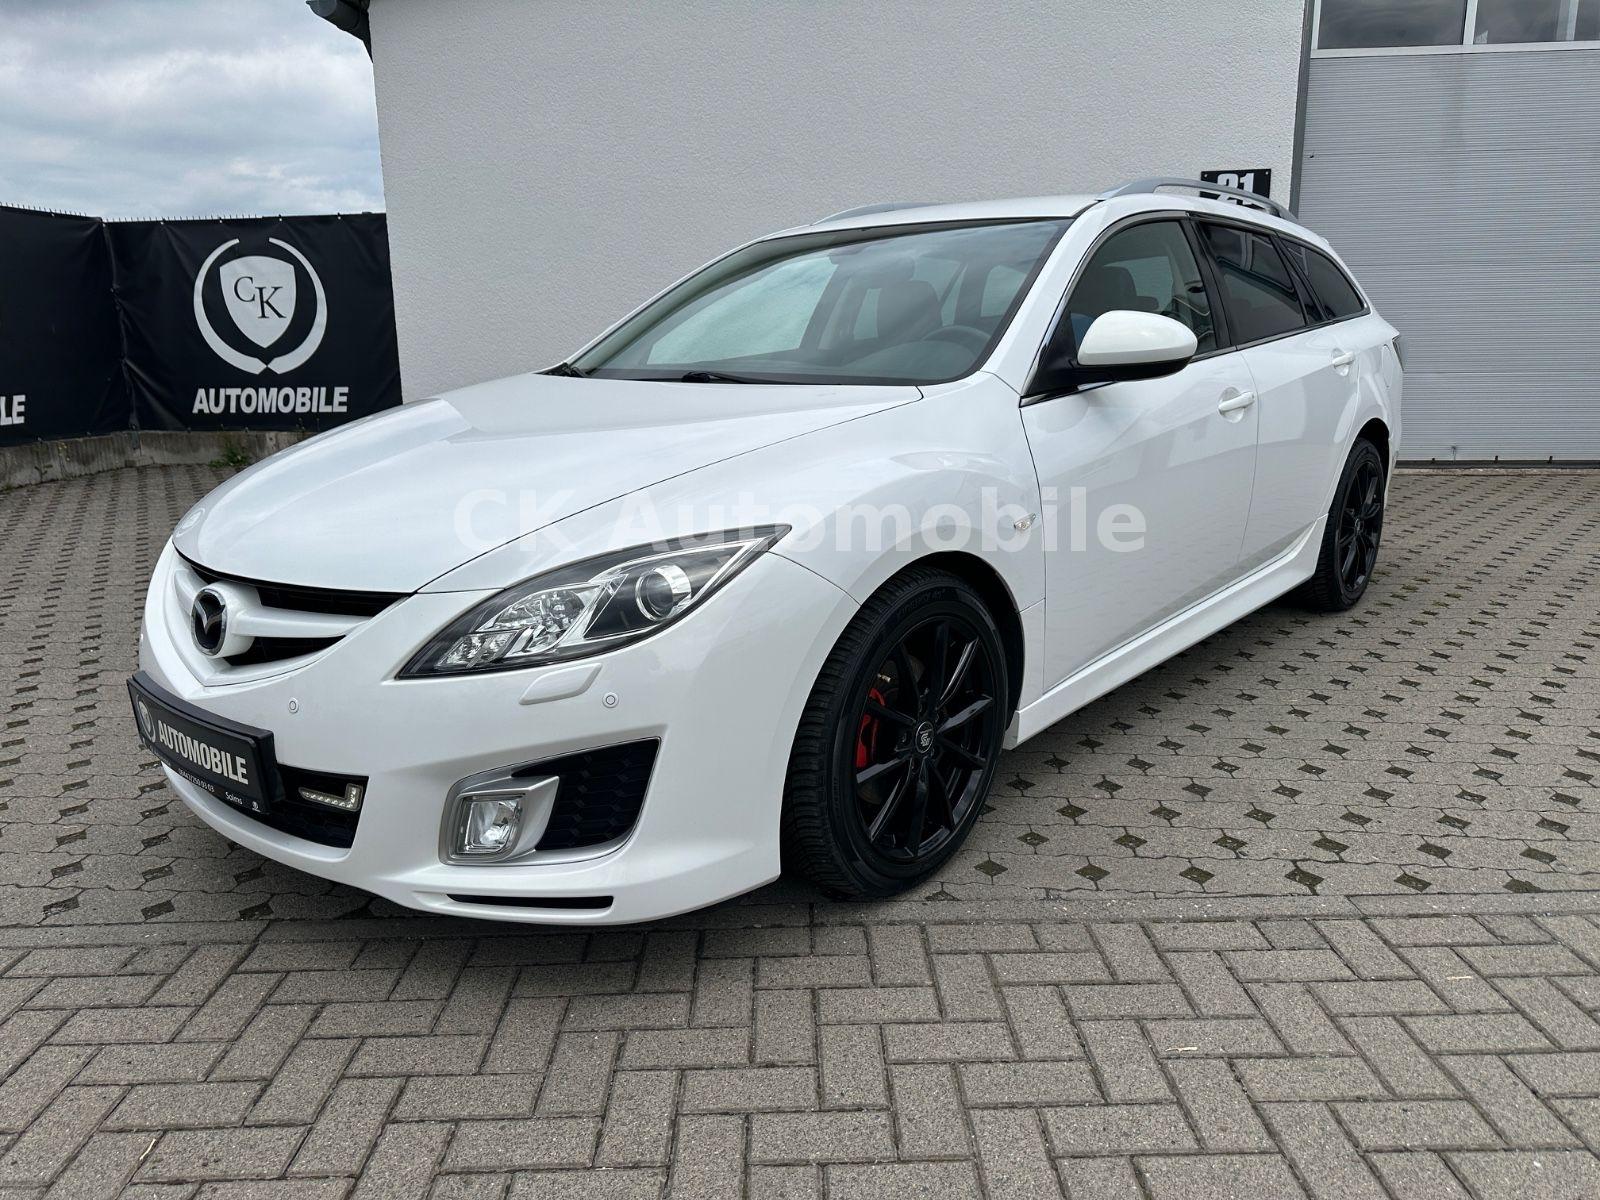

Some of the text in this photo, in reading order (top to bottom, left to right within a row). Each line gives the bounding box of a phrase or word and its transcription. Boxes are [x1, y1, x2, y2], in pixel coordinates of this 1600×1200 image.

[234, 277, 287, 319] CK
[0, 395, 26, 426] LE
[193, 387, 349, 414] AUTOMOBILE
[158, 720, 248, 784] AUTOMOBILE
